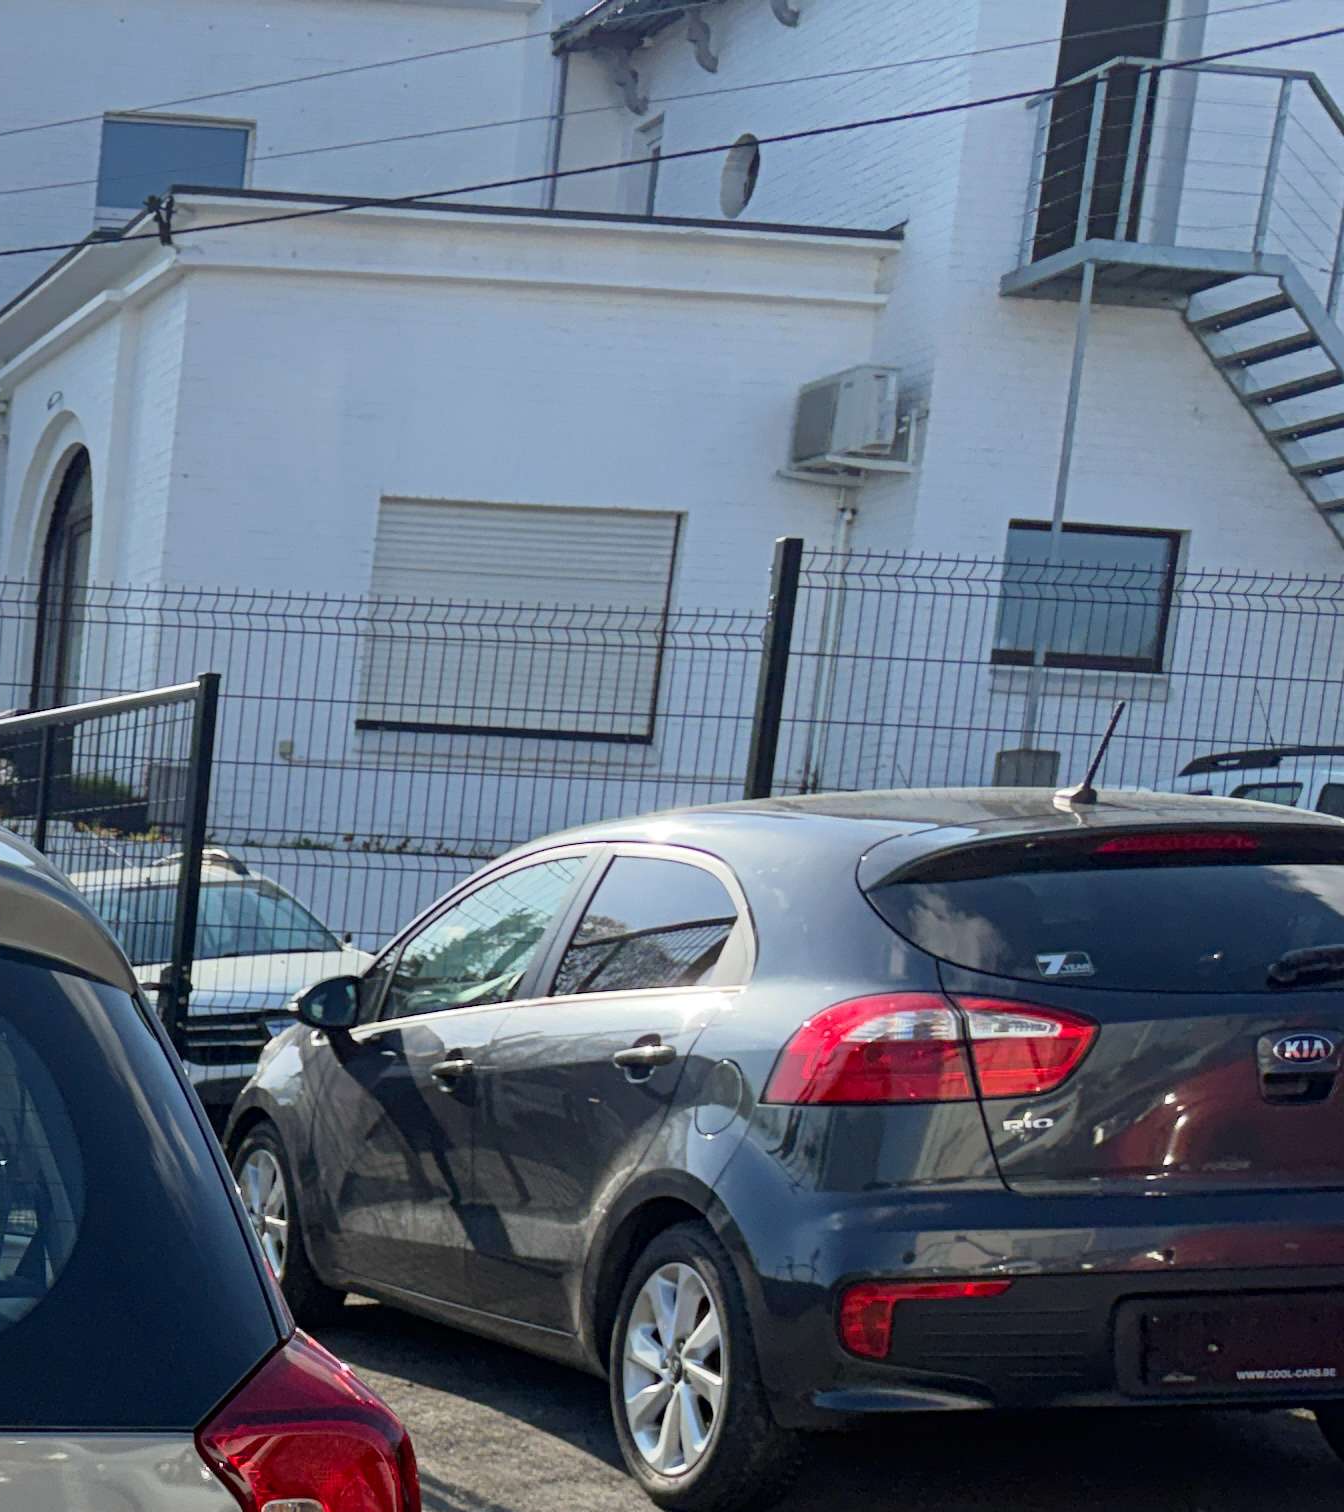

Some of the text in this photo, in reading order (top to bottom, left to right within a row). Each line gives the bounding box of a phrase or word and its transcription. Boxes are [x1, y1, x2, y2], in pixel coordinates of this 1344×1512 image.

[1038, 954, 1067, 975] 7
[1284, 1039, 1326, 1058] KIA
[1235, 1367, 1337, 1381] WWW.COOL-CARS.BE
